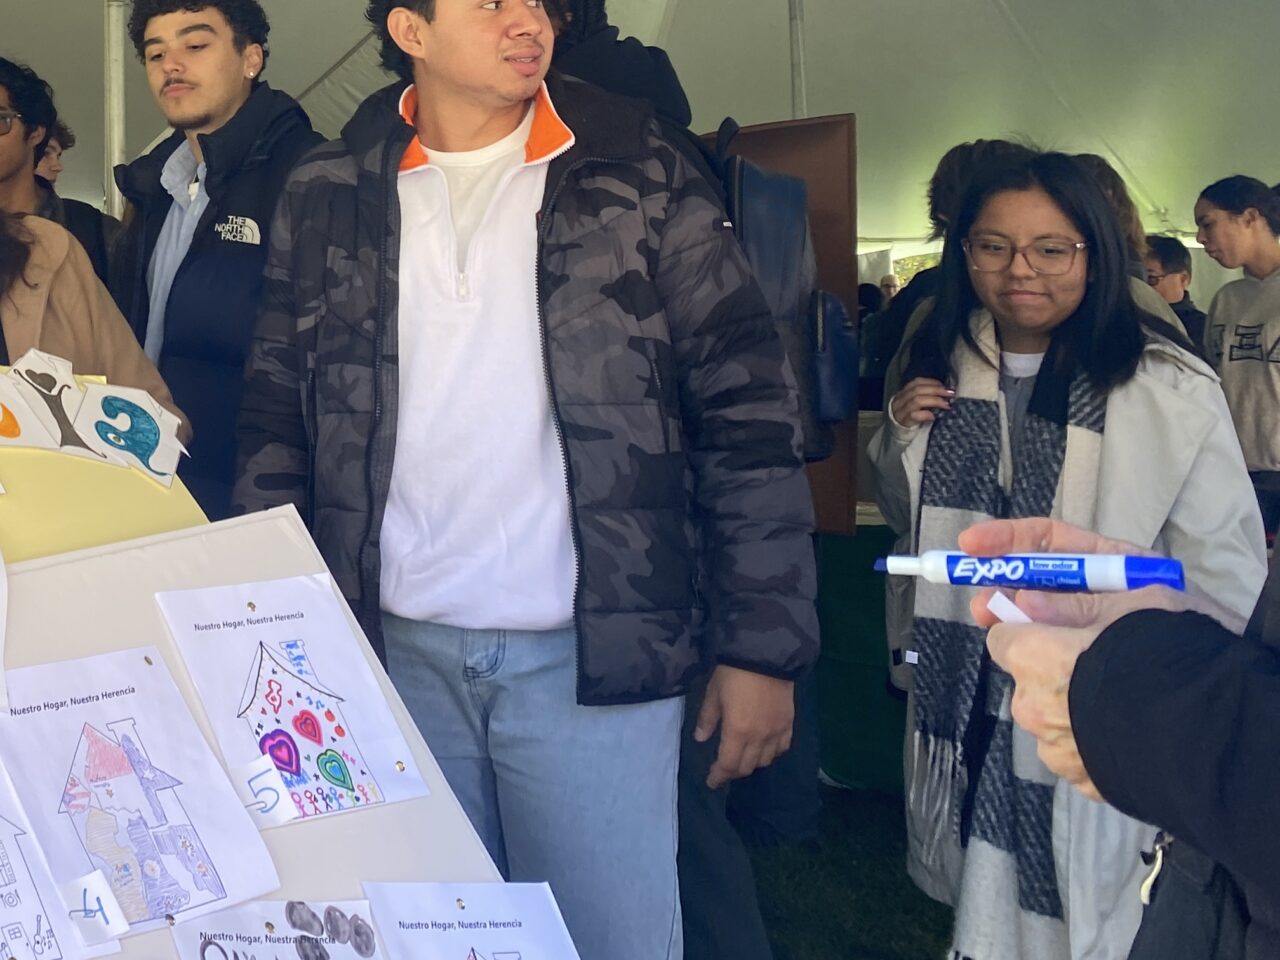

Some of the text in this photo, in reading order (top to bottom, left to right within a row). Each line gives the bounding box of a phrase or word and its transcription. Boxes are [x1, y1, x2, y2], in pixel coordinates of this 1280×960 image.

[228, 216, 246, 225] THE
[214, 223, 244, 234] NORTH
[221, 232, 244, 241] FACE
[953, 558, 1024, 584] EXPO
[1032, 560, 1074, 569] low odor
[194, 611, 304, 631] Nuestro Hogar, Nuestra Herencia
[10, 686, 136, 716] Nuestro Hogar, Nuestra Herencia
[247, 768, 280, 813] 5
[82, 888, 110, 926] 4
[399, 919, 522, 931] Nuestro Hogar, Nuestra Herencia
[200, 932, 234, 942] Nuestro
[236, 934, 262, 945] Hogar,
[264, 935, 296, 944] Nuestra
